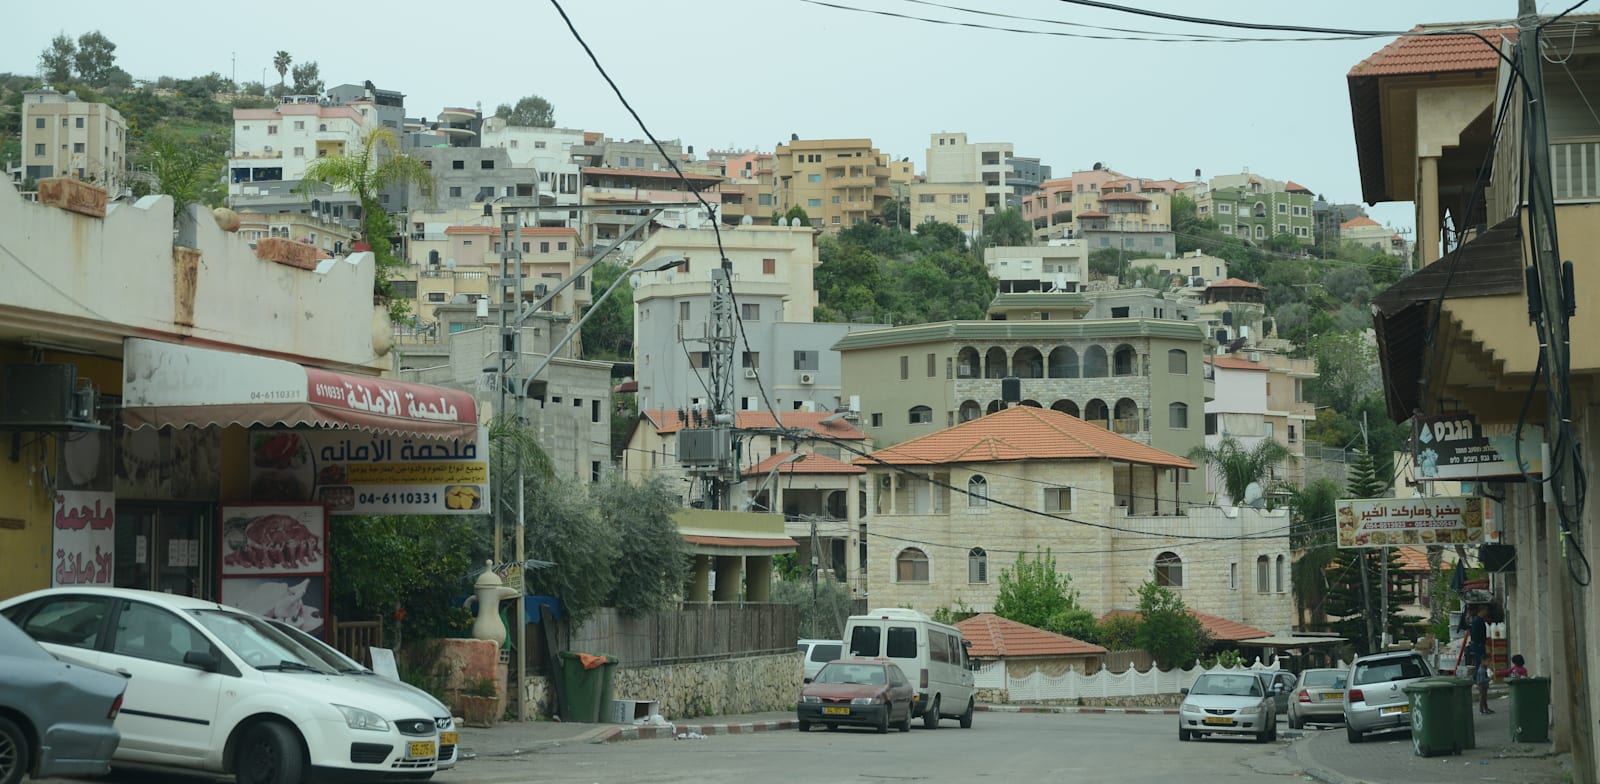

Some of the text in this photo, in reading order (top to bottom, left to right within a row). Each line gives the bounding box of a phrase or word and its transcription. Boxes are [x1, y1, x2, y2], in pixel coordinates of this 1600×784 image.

[250, 389, 300, 400] 04-6110331
[316, 383, 345, 400] 6110331
[406, 392, 458, 421] ملحمة
[1433, 419, 1473, 442] הגבס
[400, 438, 477, 461] ملحمة
[359, 493, 438, 504] 04-6110331
[55, 494, 114, 531] ملحمة
[1361, 505, 1460, 520] مخبز وماركت الخير
